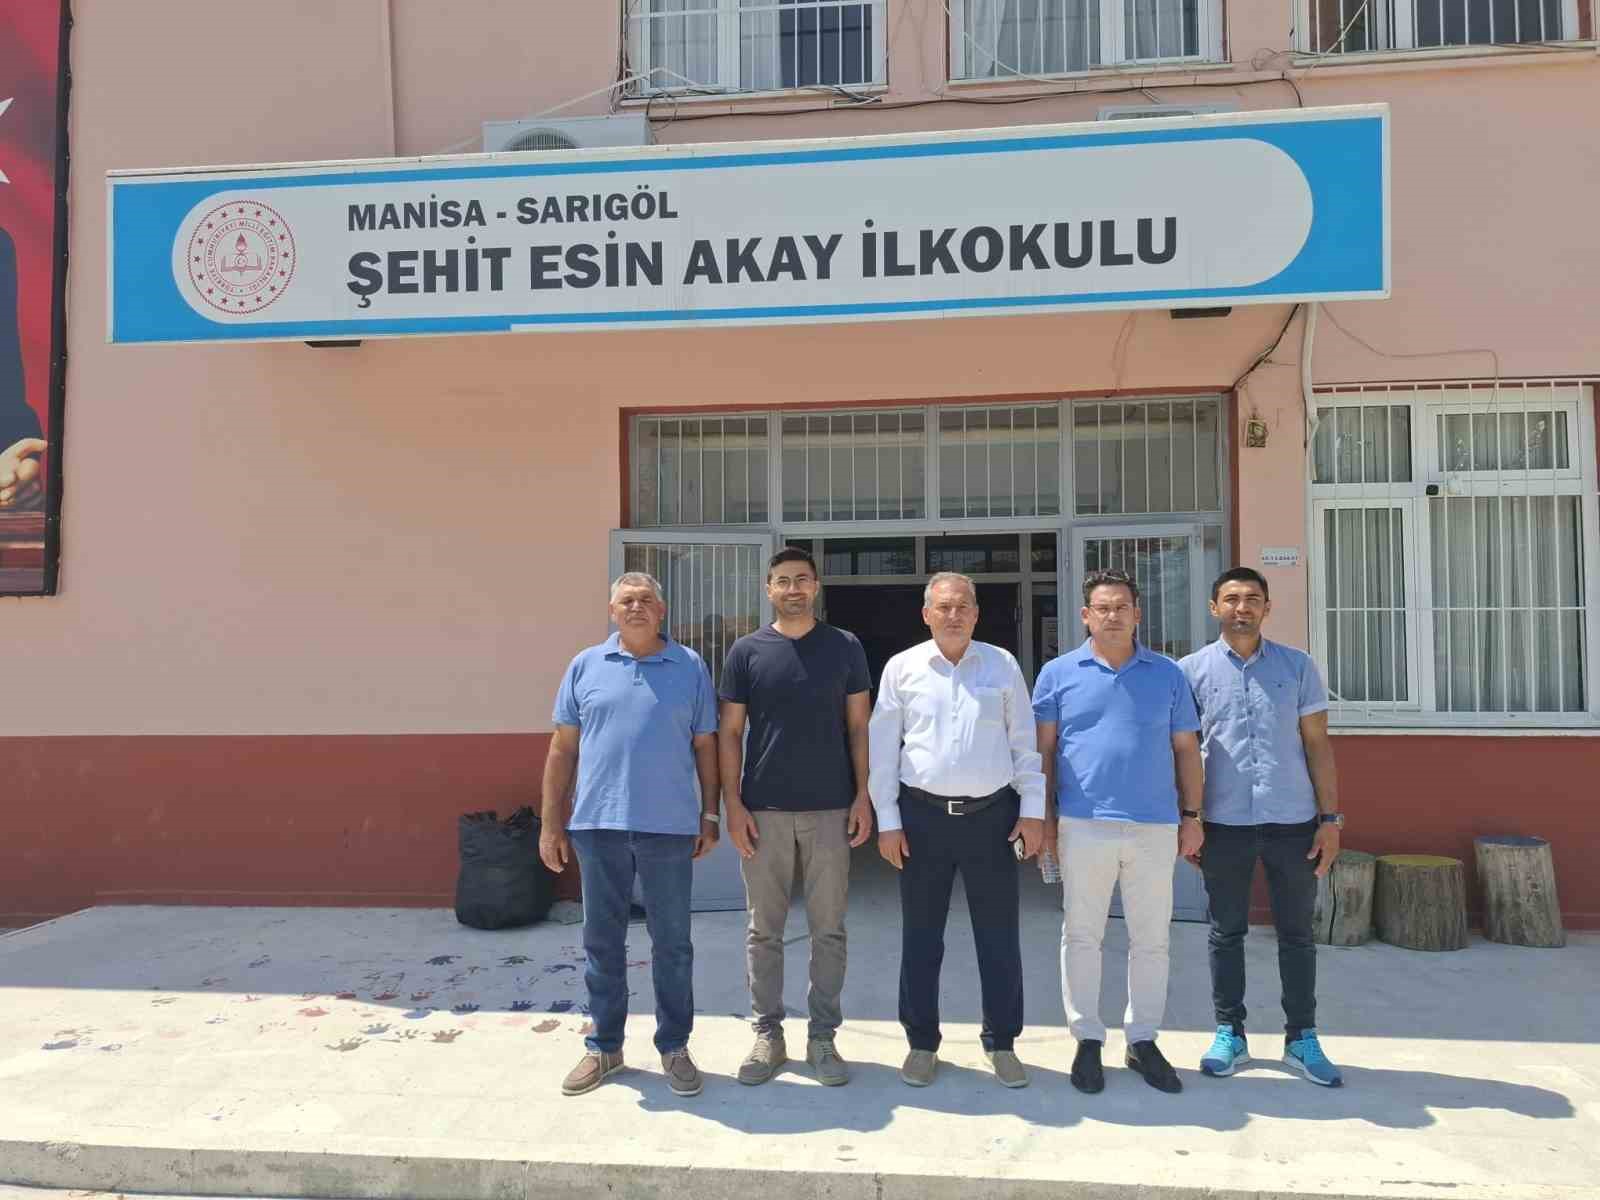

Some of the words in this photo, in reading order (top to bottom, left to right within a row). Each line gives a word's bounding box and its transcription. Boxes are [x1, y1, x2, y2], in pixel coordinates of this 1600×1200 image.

[348, 194, 487, 232] MANİSA
[516, 184, 678, 227] SARIGÖL
[346, 235, 512, 309] ŞEHİT
[530, 230, 663, 290] ESİN
[683, 233, 843, 284] AKAY
[862, 216, 1177, 278] İLKOKULU
